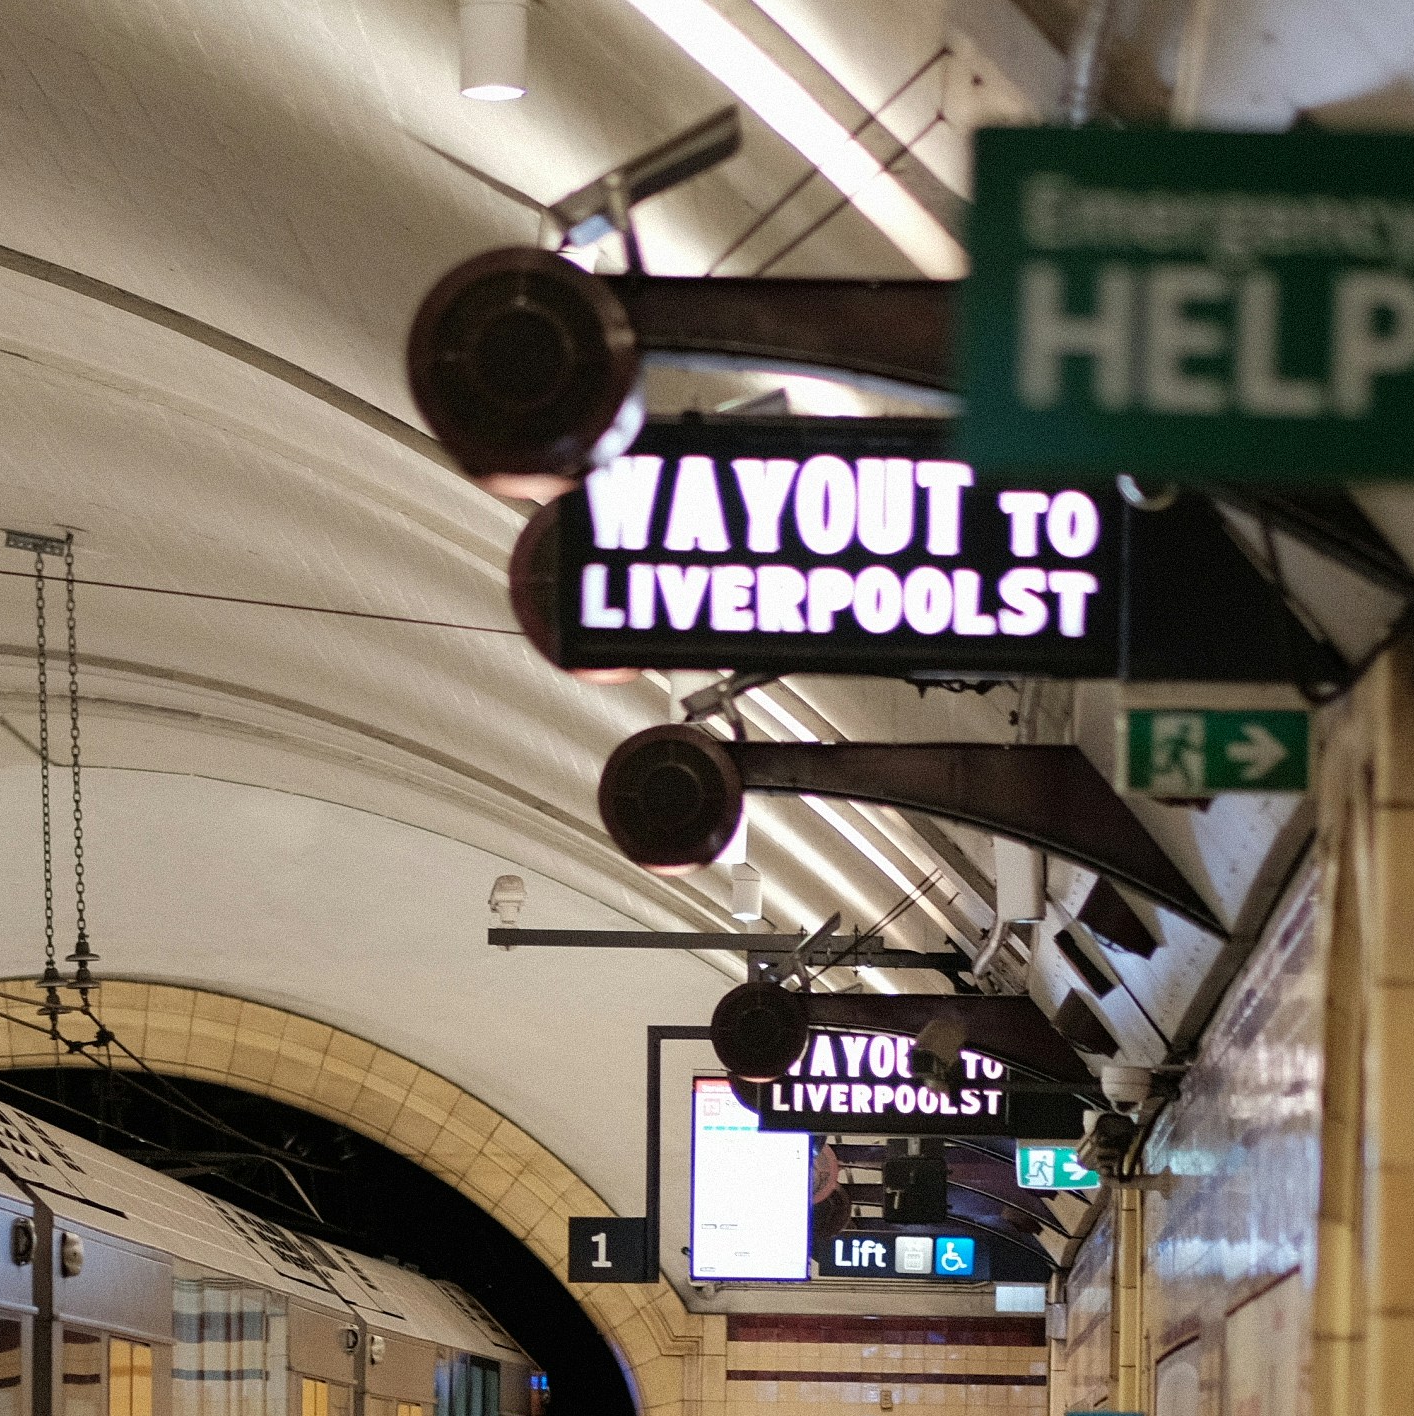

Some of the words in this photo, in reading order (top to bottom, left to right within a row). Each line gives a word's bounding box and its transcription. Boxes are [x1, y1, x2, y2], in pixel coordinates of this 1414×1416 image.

[998, 490, 1101, 558] TO
[591, 1232, 612, 1268] 1
[834, 1239, 887, 1268] Lift
